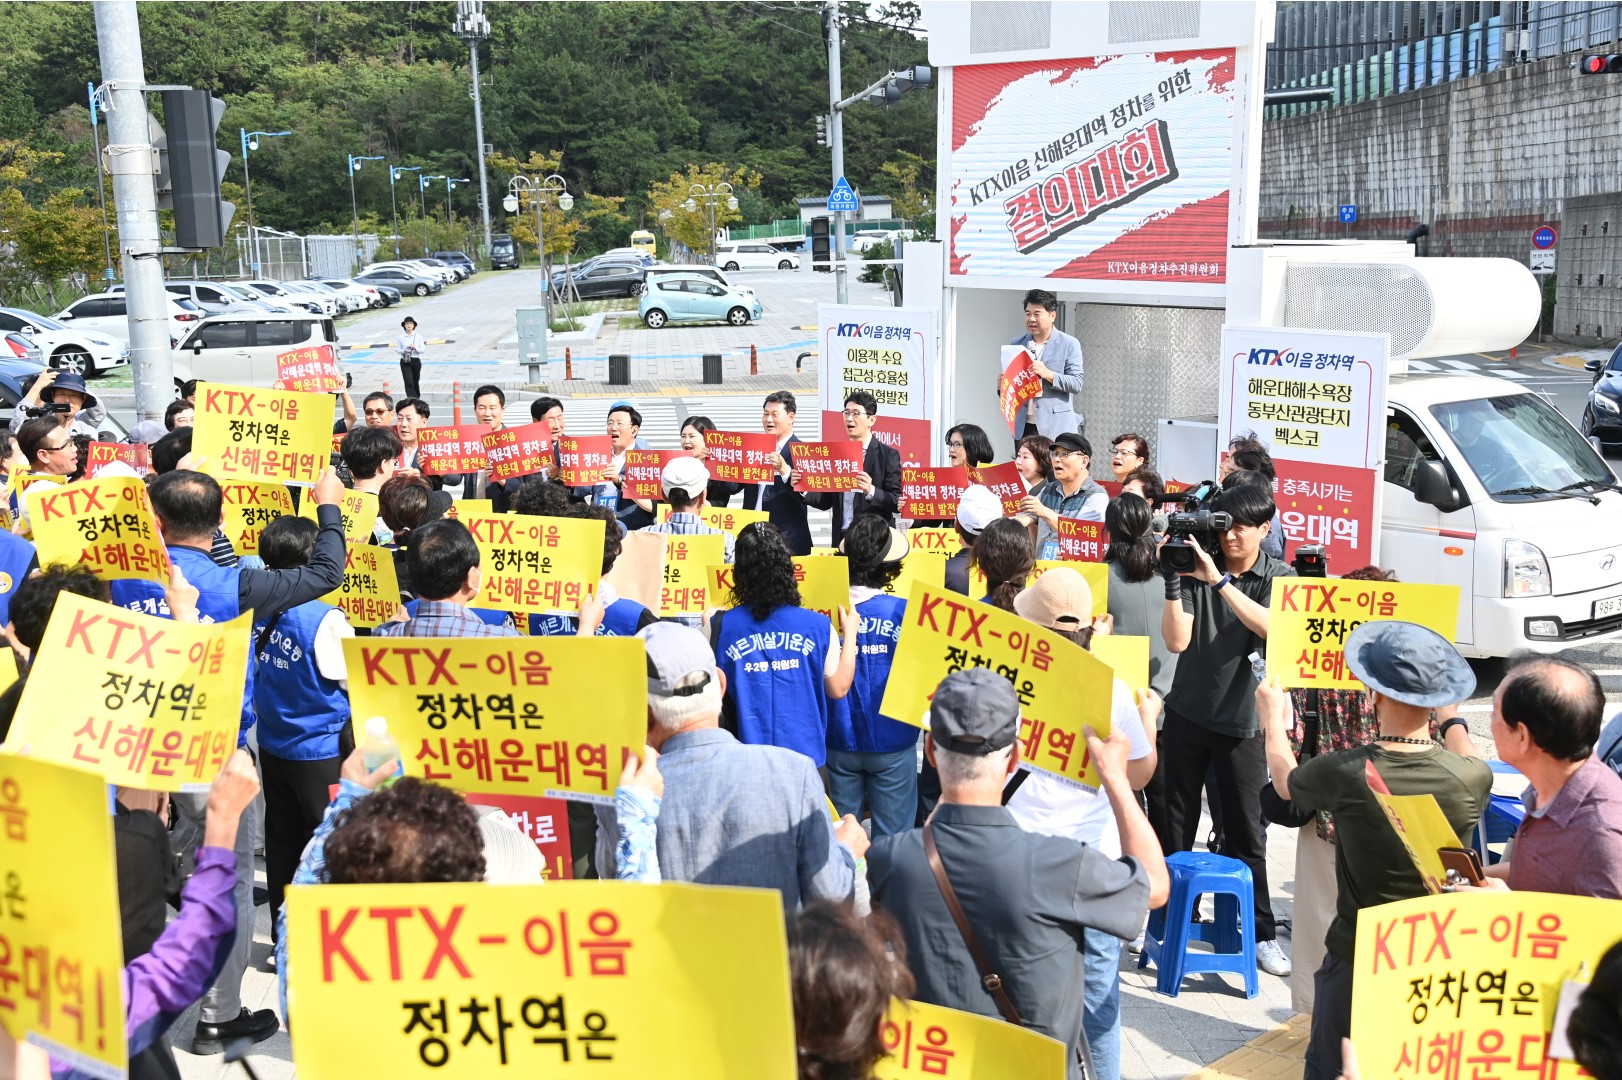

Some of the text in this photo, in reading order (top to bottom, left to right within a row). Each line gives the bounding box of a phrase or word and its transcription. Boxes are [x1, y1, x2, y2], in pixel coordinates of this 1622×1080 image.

[970, 68, 1193, 206] KTX이음 신해운대역 정차를 위한
[1005, 120, 1173, 252] 결의대회
[1345, 213, 1351, 221] P
[279, 350, 319, 367] KTX-이음
[847, 348, 903, 365] 이용객 수요
[293, 378, 321, 391] 해운대
[1248, 377, 1352, 403] 해운대해수욕장
[206, 389, 300, 421] KTX-이음
[1247, 400, 1351, 427] 동부산관광단지
[229, 420, 291, 446] 정차역은
[418, 429, 459, 442] KTX-이음
[483, 431, 516, 447] KTX-이음
[706, 432, 743, 447] KTX-이음
[1274, 427, 1319, 447] 벡스코
[92, 446, 136, 462] KTX-이음
[421, 442, 460, 457] 신해운대역
[487, 440, 549, 464] 신해운대역 정차로
[627, 452, 660, 464] KTX-이음
[709, 447, 772, 465] 신해운대역 정차로
[791, 444, 830, 457] KTX-이음
[430, 458, 458, 471] 해운대
[496, 461, 520, 476] 해운대
[583, 452, 608, 467] 정차로
[796, 458, 859, 473] 신해운대역 정차로
[627, 467, 661, 481] 신해운대역
[716, 464, 773, 482] 해운대 발전을!
[807, 475, 831, 488] 해운대
[902, 469, 935, 482] KTX-이음
[635, 483, 658, 496] 해운대
[902, 484, 937, 500] 신해운대역
[1283, 478, 1353, 503] 충족시키는
[909, 502, 957, 516] 해운대 발전
[77, 514, 151, 541] 정차역은
[467, 518, 561, 547] KTX-이음
[1059, 520, 1098, 538] KTX-이음
[1276, 507, 1358, 549] 운대역
[912, 532, 961, 549] KTX-
[1059, 537, 1098, 558] 신해운대역
[345, 548, 377, 571] X-이음
[491, 548, 553, 573] 정차역은
[1281, 585, 1398, 616] KTX-이음
[917, 592, 1054, 672] KTX-이음
[65, 608, 225, 676] KTX-이음
[725, 631, 816, 662] 바르게살기운동
[861, 644, 888, 655] 위원회
[361, 647, 553, 686] KTX-이음
[744, 658, 800, 673] 우2동 위원회
[101, 671, 207, 721] 정차역은
[416, 693, 545, 730] 정차역은
[319, 904, 633, 983] KTX-이음
[1372, 908, 1568, 975] KTX-이음
[1407, 969, 1539, 1024] 정차역은
[402, 994, 618, 1068] 정차역은
